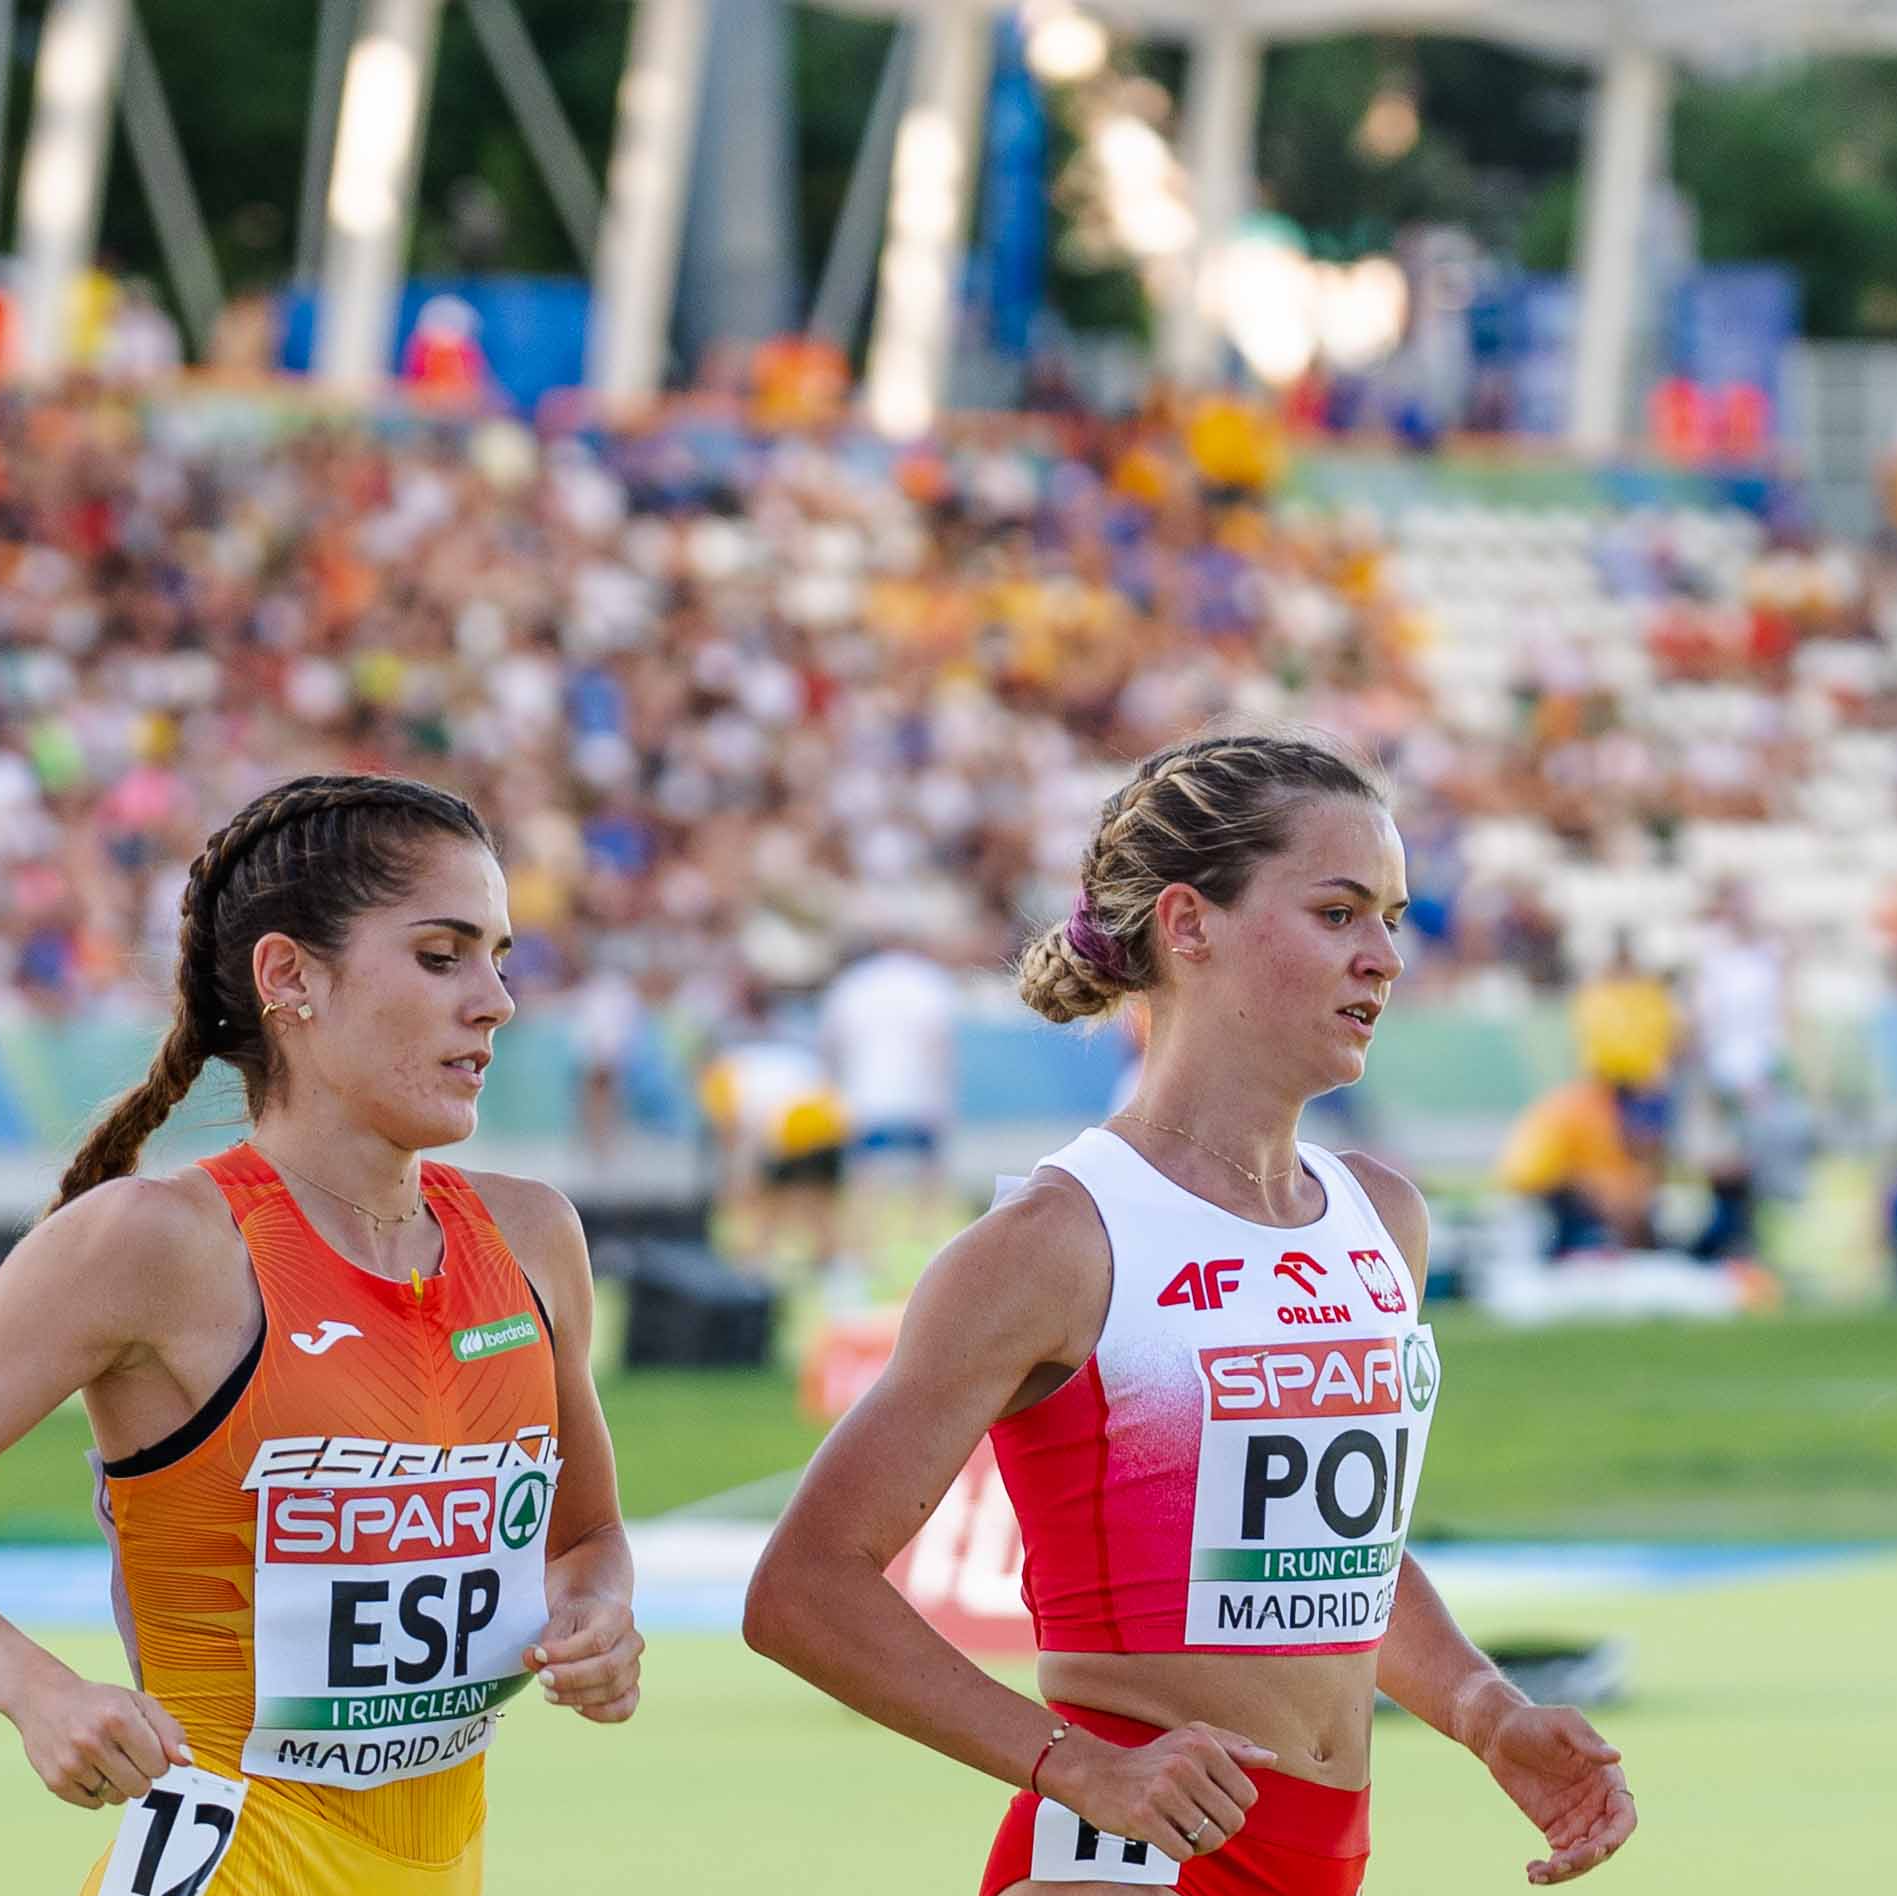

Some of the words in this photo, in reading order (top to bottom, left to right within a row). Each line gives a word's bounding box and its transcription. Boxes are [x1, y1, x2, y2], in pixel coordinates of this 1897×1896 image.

[1277, 1304, 1352, 1325] ORLEN
[483, 1321, 536, 1348] Iberdrola
[1210, 1348, 1399, 1409] SPAR
[274, 1488, 491, 1553] SPAR
[1264, 1552, 1272, 1577] I
[1278, 1551, 1336, 1577] RUN
[328, 1567, 501, 1688] ESP
[1218, 1591, 1370, 1630] MADRID
[331, 1700, 340, 1727] I
[348, 1696, 406, 1726] RUN
[277, 1735, 440, 1776] MADRID
